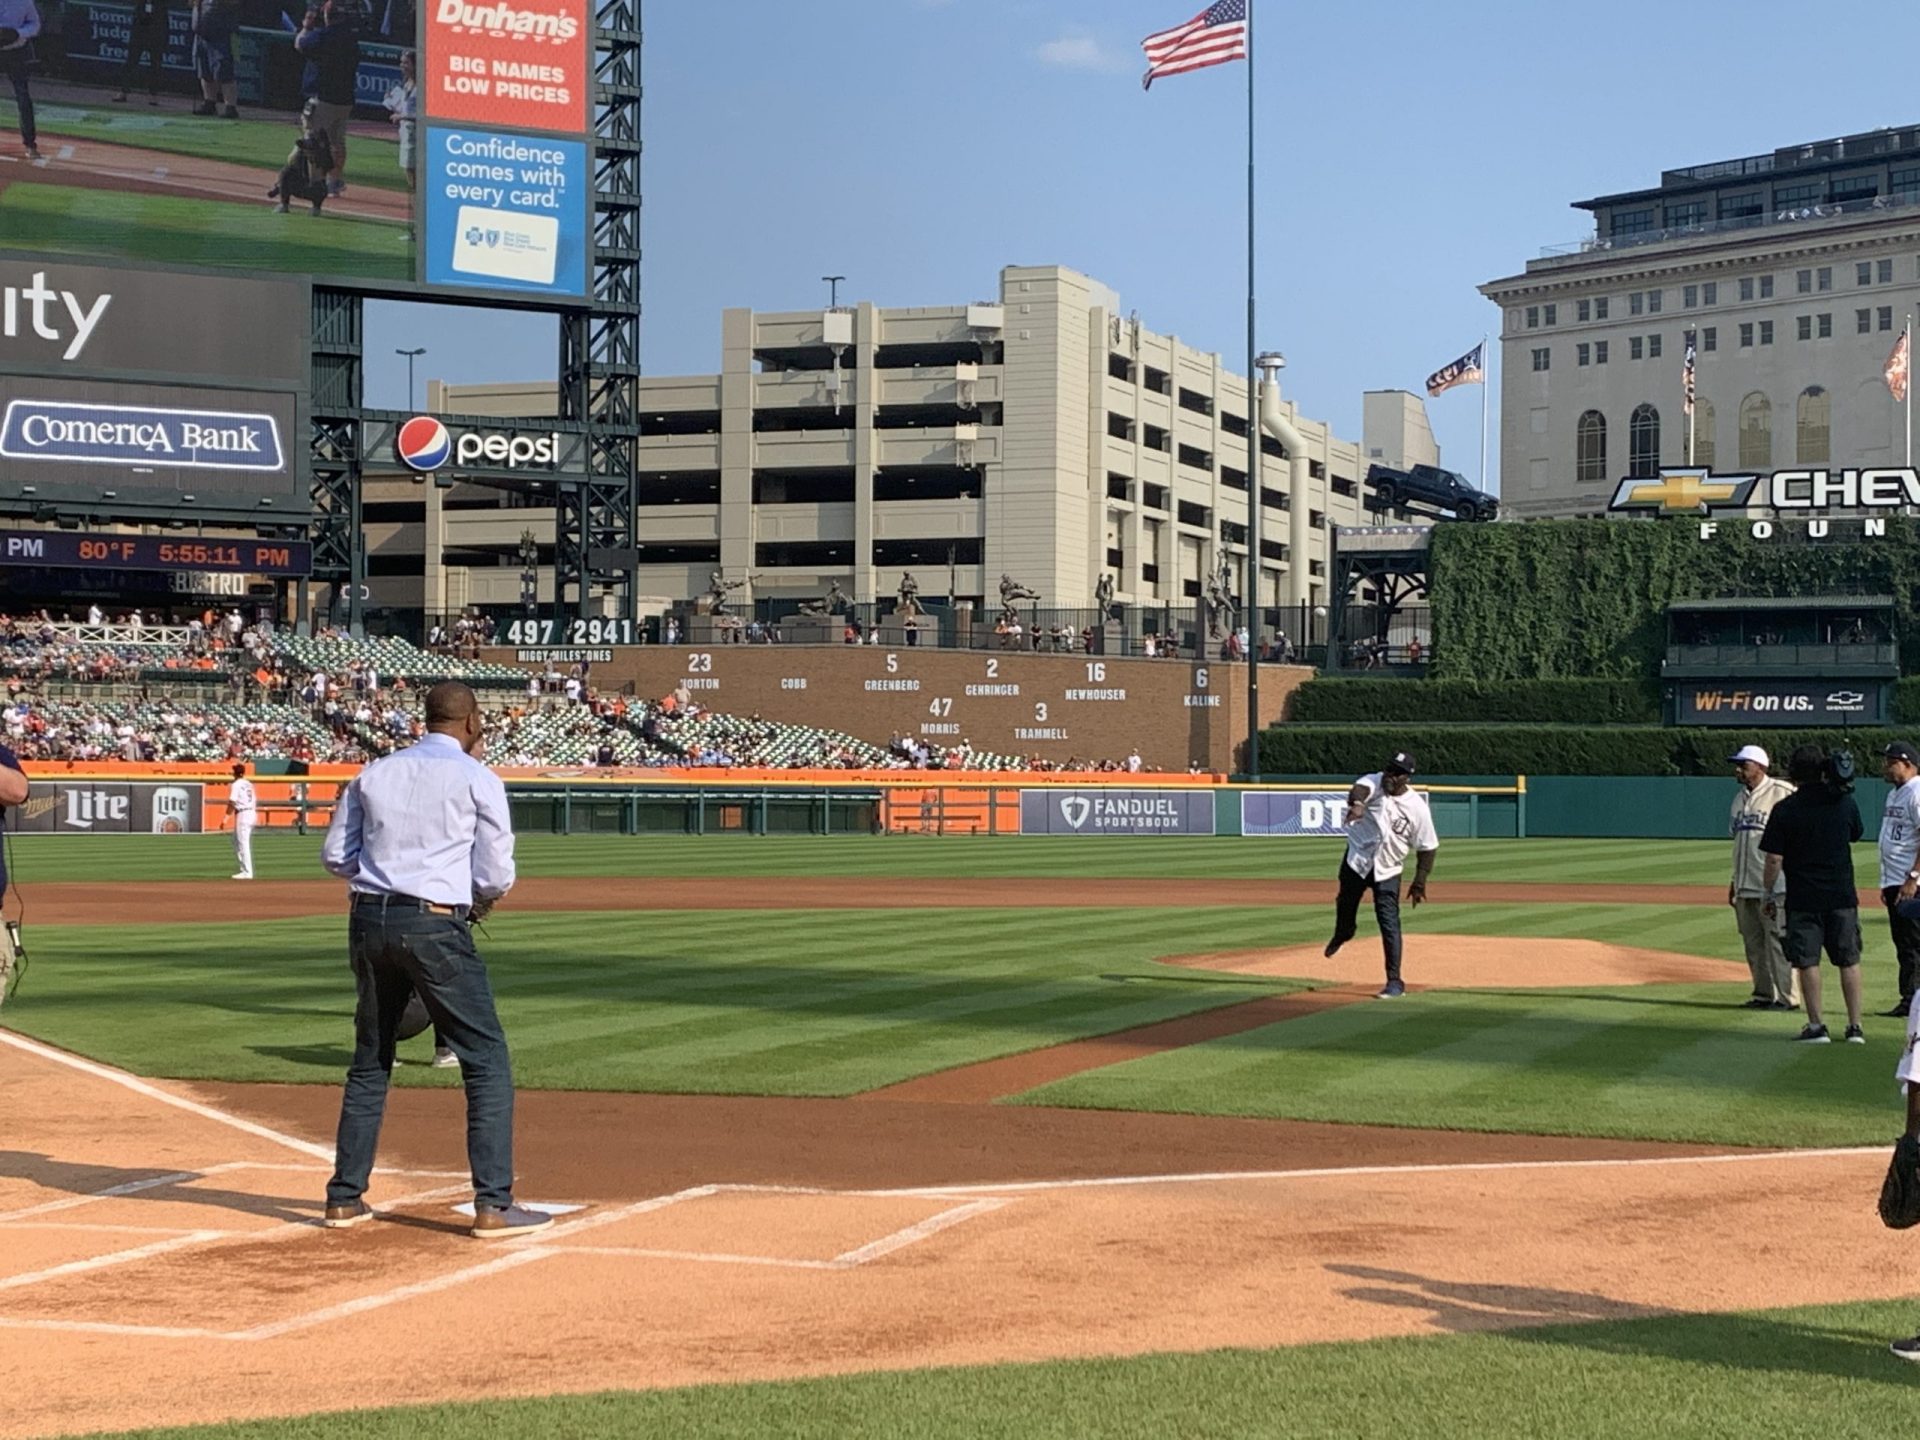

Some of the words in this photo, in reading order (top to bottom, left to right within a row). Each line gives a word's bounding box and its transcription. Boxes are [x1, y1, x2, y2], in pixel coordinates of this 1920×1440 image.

[436, 0, 578, 38] Dunham's
[451, 25, 569, 45] SPORTS
[449, 55, 487, 75] BIG
[491, 59, 565, 84] NAMES
[443, 74, 490, 95] LOW
[495, 80, 571, 105] PRICES
[445, 134, 566, 166] Confidence
[445, 162, 515, 183] comes
[520, 166, 566, 188] with
[445, 184, 504, 208] every
[509, 189, 561, 209] card.
[180, 422, 261, 452] Bank
[457, 432, 560, 468] pepsi
[7, 537, 44, 558] PM
[158, 543, 241, 566] 5:55:11
[255, 547, 290, 567] PM
[507, 619, 554, 645] 497
[573, 619, 631, 645] 2941
[688, 653, 712, 672] 23
[886, 653, 899, 673] 5
[986, 658, 999, 678] 2
[1086, 662, 1106, 682] 16
[780, 678, 808, 690] COBB
[863, 680, 921, 692] GREENBERG
[1195, 668, 1208, 688] 6
[965, 684, 1021, 697] GEHRINGER
[1065, 689, 1127, 701] NEWHOUSER
[928, 698, 953, 717] 47
[1183, 695, 1222, 708] KALINE
[1695, 691, 1751, 711] Wi-Fi
[1752, 694, 1779, 711] on
[1783, 695, 1814, 711] us.
[1035, 703, 1049, 722] 3
[920, 723, 961, 735] MORRIS
[1014, 728, 1070, 740] TRAMMELL
[63, 789, 128, 828] Lite
[156, 795, 187, 815] Lite
[1094, 799, 1178, 816] FANDUEL
[1095, 817, 1179, 828] SPORTSBOOK
